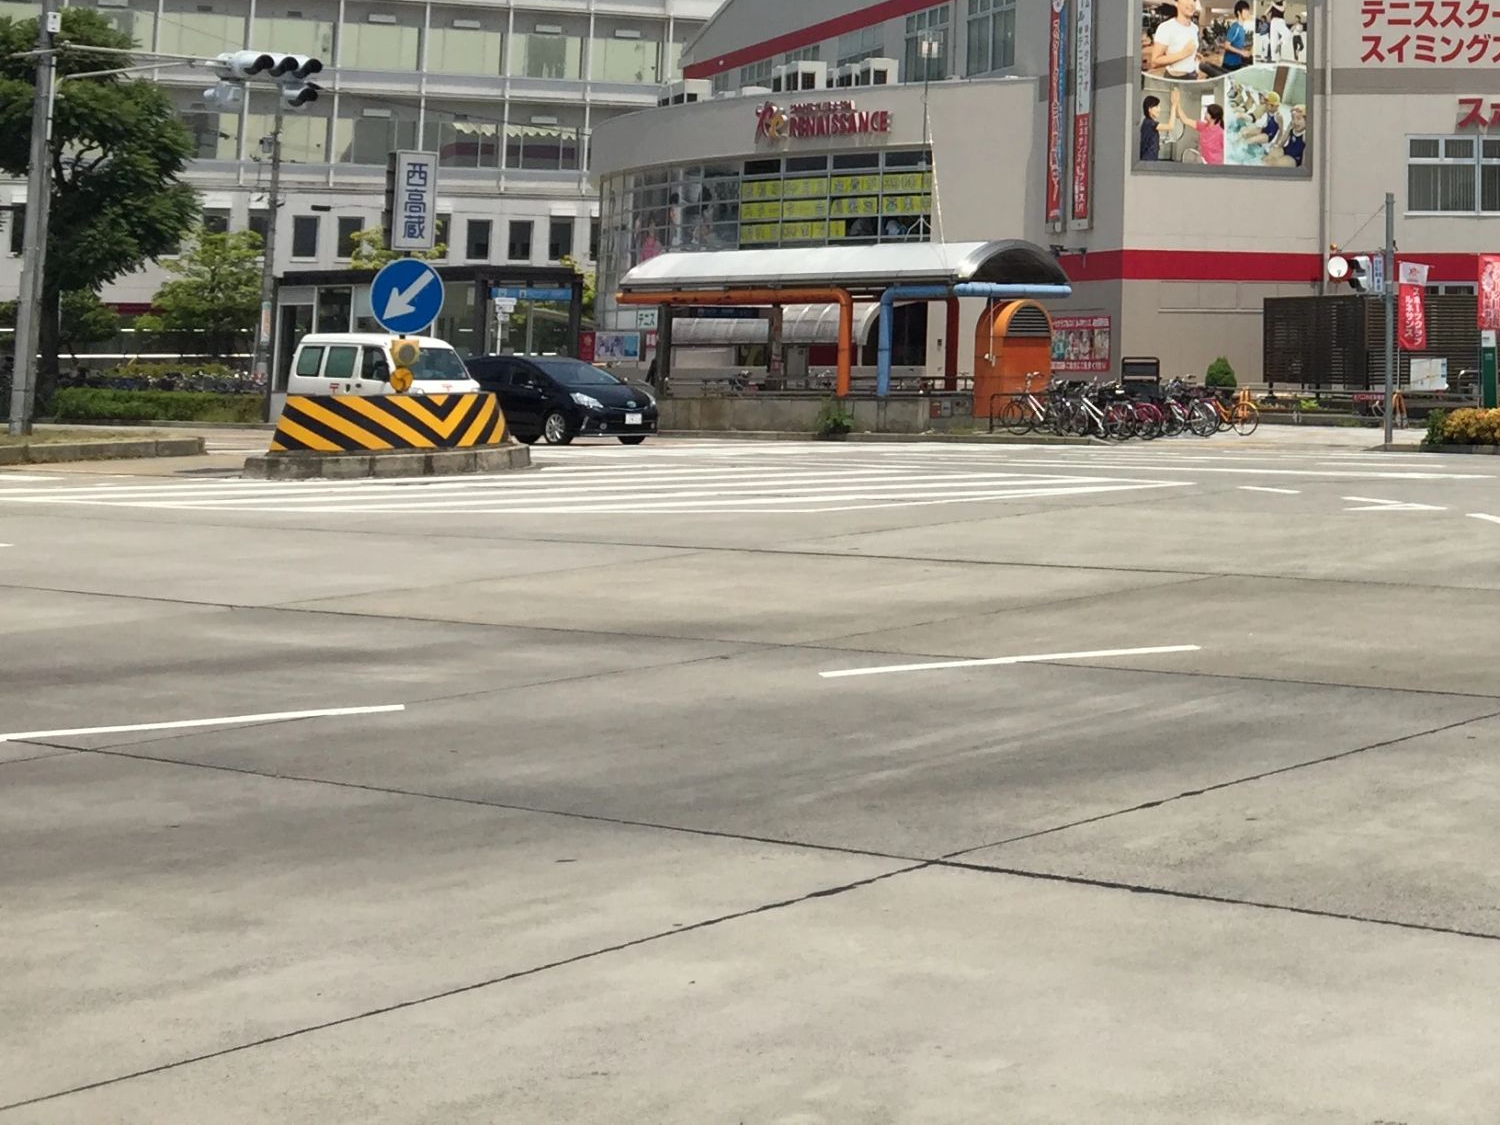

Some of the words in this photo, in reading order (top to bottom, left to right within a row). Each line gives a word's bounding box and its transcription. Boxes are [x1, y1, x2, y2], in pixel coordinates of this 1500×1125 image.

[788, 111, 888, 137] RENAISSANCE
[403, 162, 428, 239] 西高蔵
